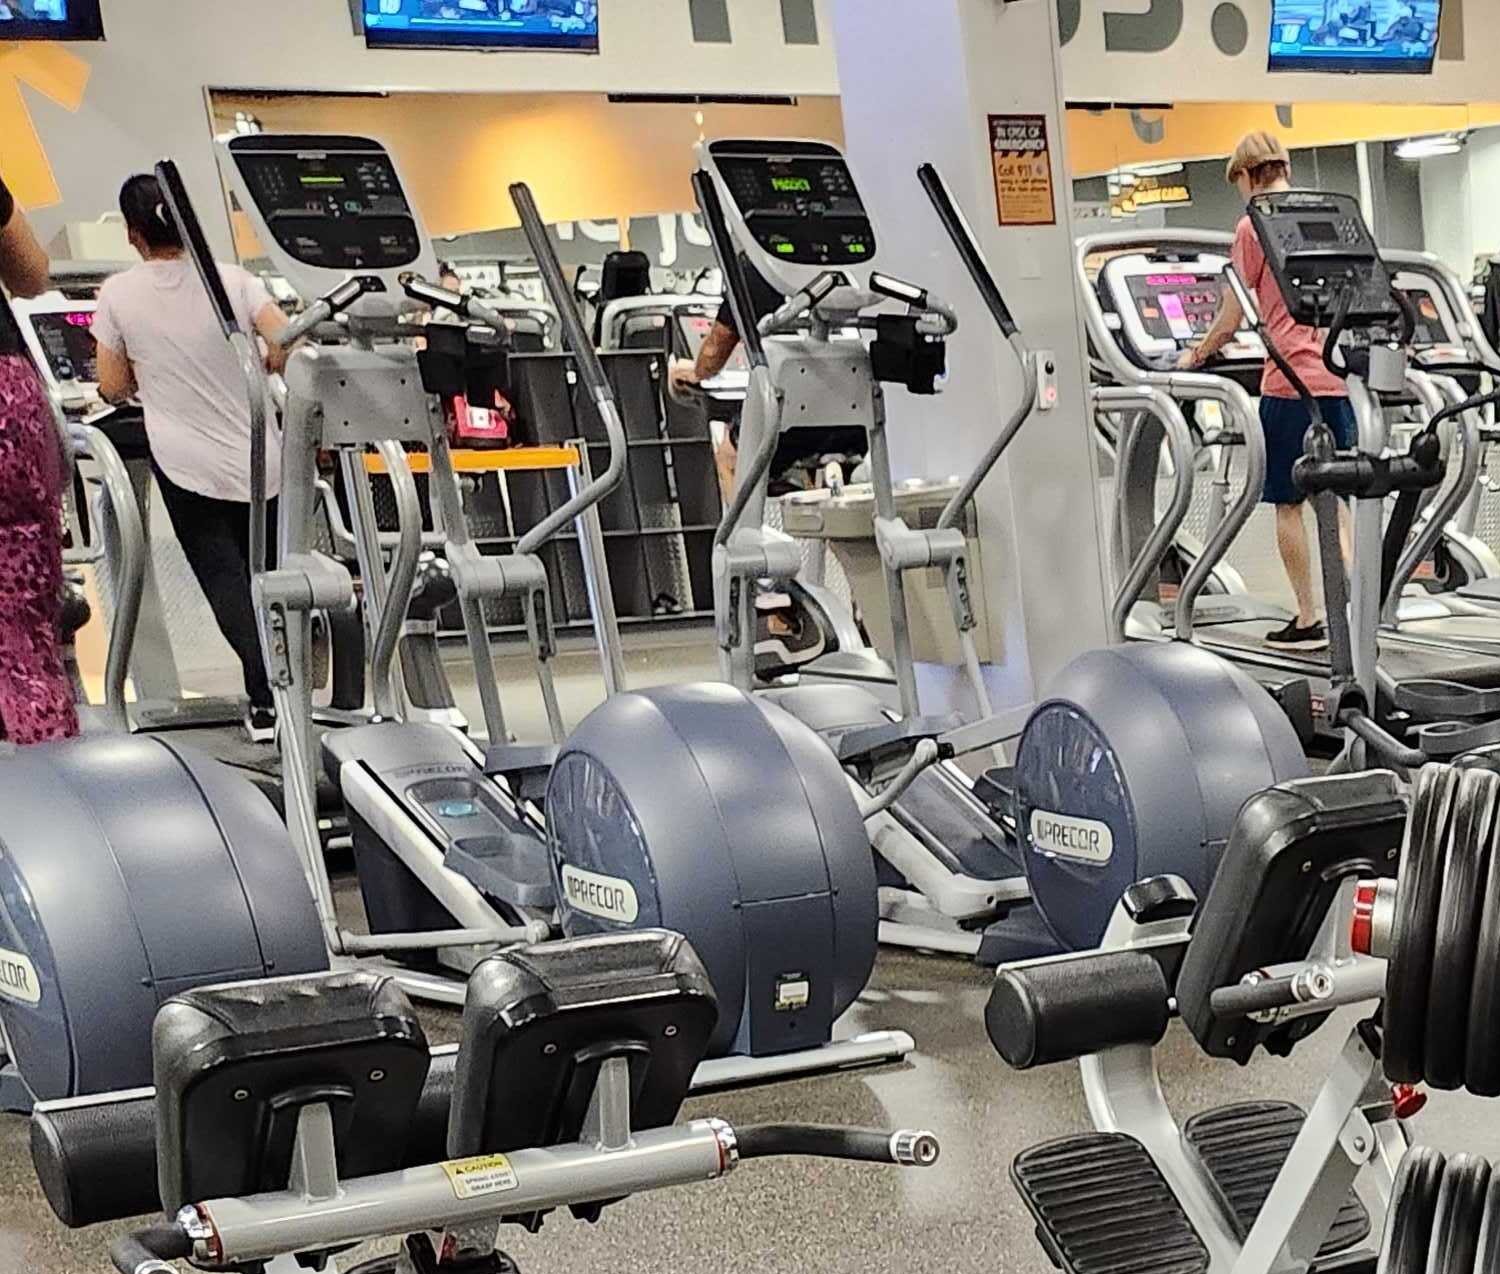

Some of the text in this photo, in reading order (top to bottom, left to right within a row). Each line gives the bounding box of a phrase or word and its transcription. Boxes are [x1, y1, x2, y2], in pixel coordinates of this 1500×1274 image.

[1045, 821, 1099, 853] PRECOR
[574, 878, 626, 914] PRECOR
[0, 959, 30, 992] COR
